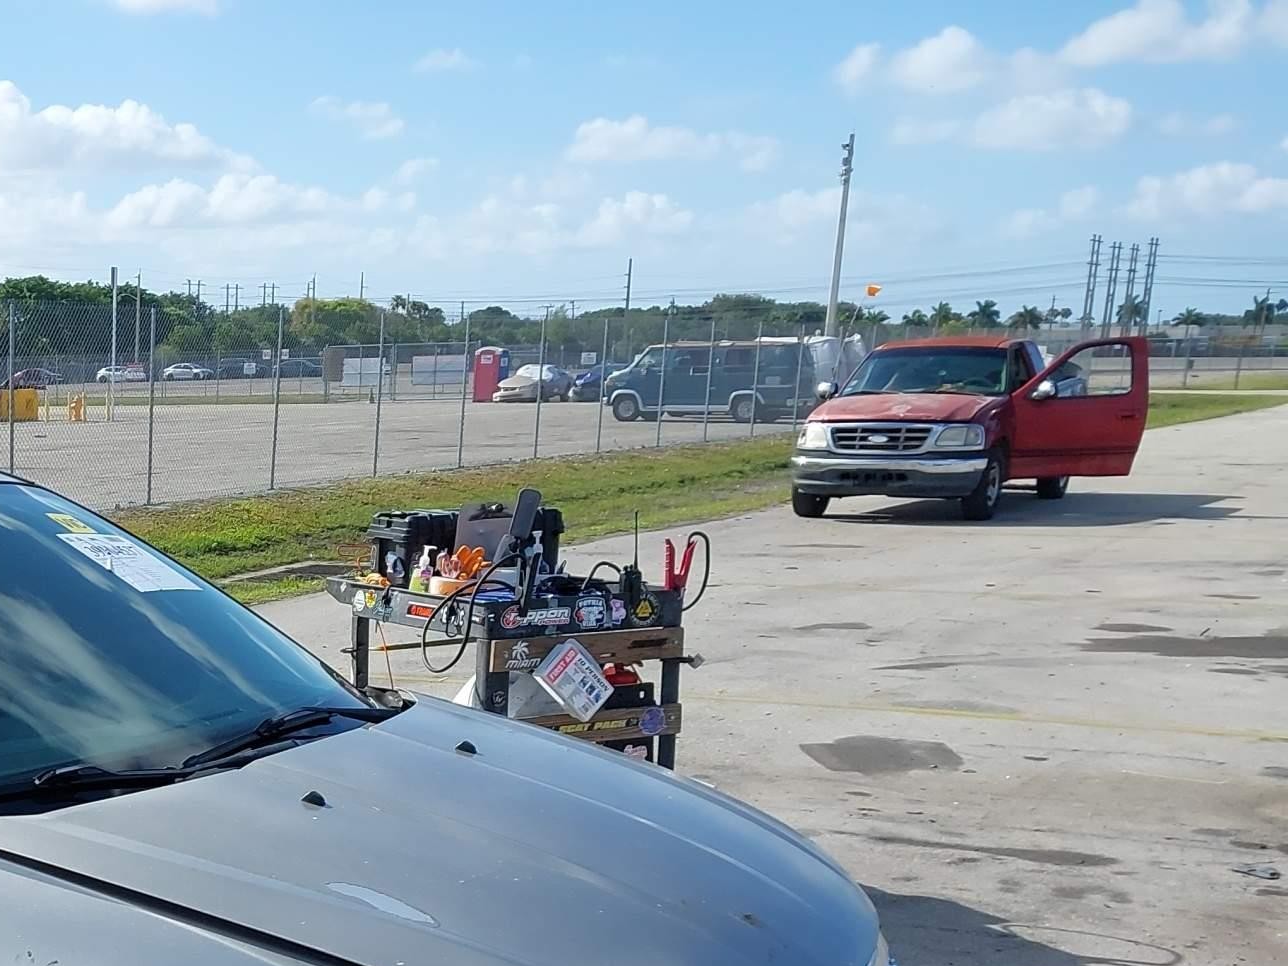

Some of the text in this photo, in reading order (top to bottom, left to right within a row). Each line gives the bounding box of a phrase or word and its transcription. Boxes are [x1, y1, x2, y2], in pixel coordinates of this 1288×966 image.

[505, 658, 542, 669] MIAM
[585, 666, 610, 690] PERSON
[594, 719, 627, 731] PACK
